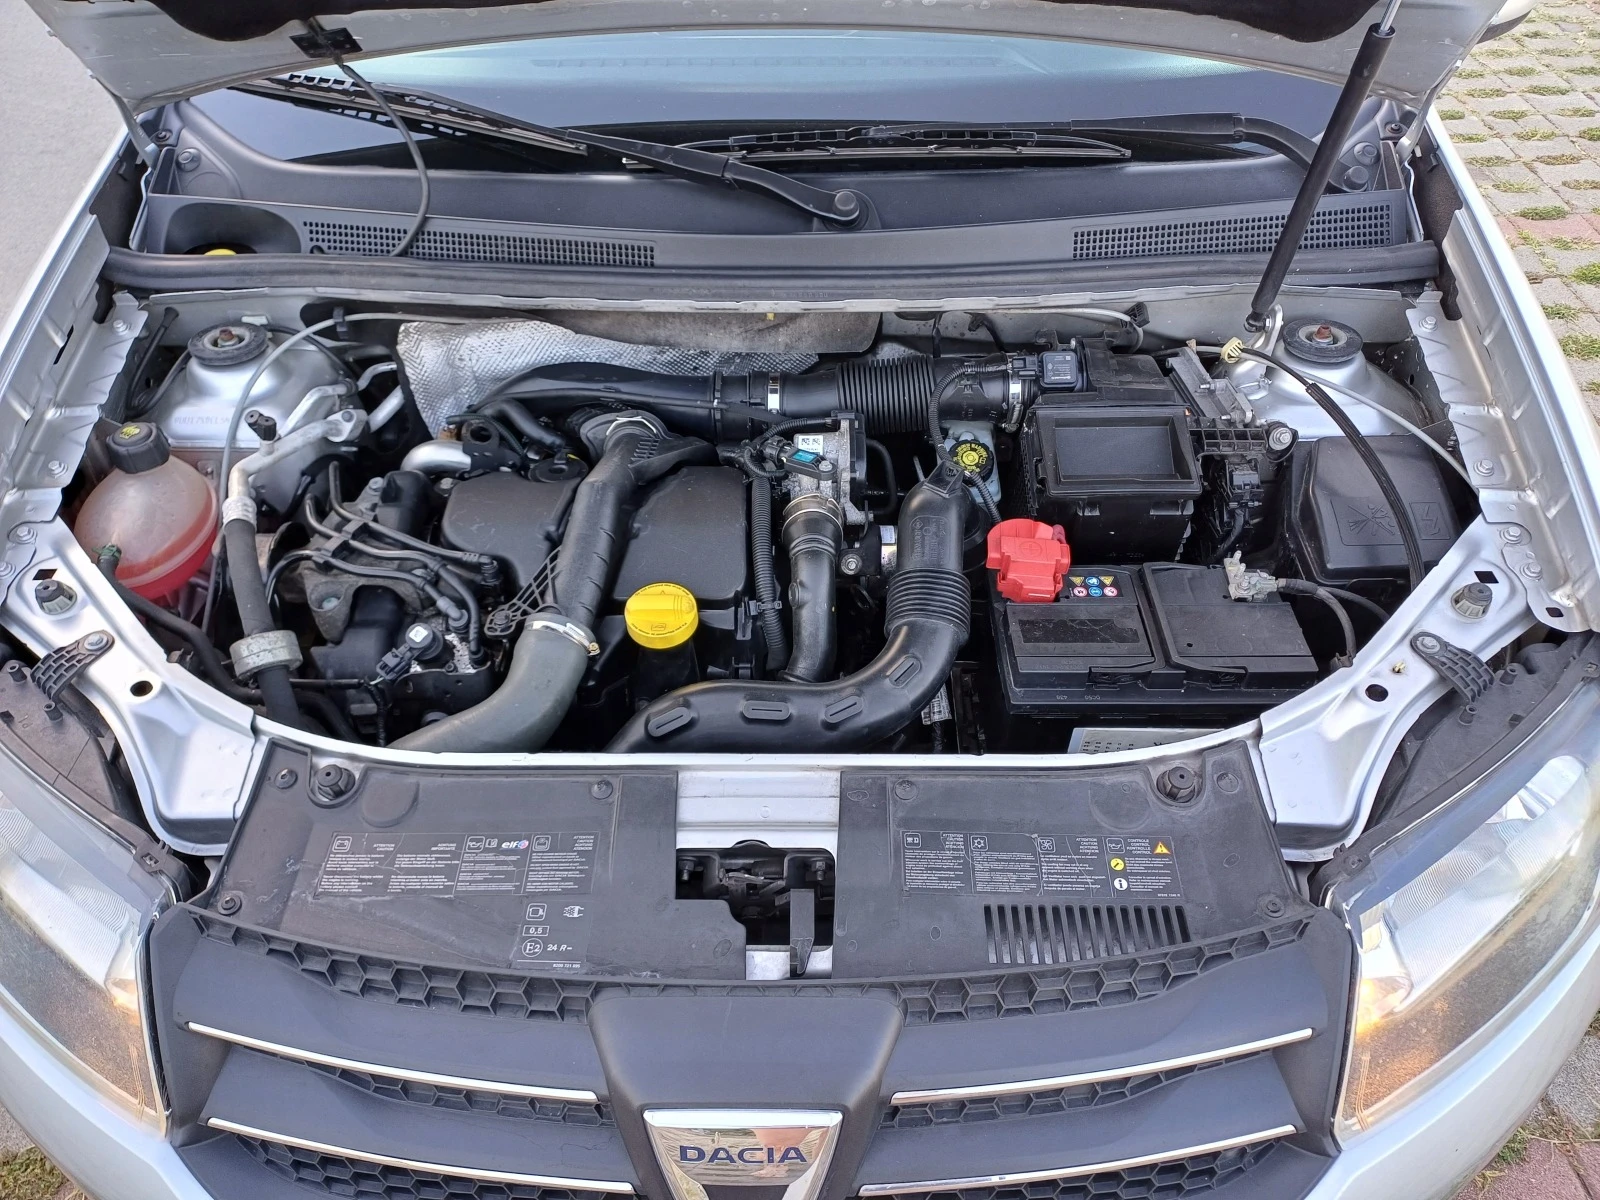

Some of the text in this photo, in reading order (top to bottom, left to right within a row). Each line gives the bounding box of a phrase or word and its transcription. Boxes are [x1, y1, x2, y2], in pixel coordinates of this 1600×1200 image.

[501, 840, 520, 849] elf
[529, 926, 543, 935] 0,5
[525, 942, 541, 954] E2
[546, 943, 558, 951] 24
[679, 1145, 808, 1164] DACIA
